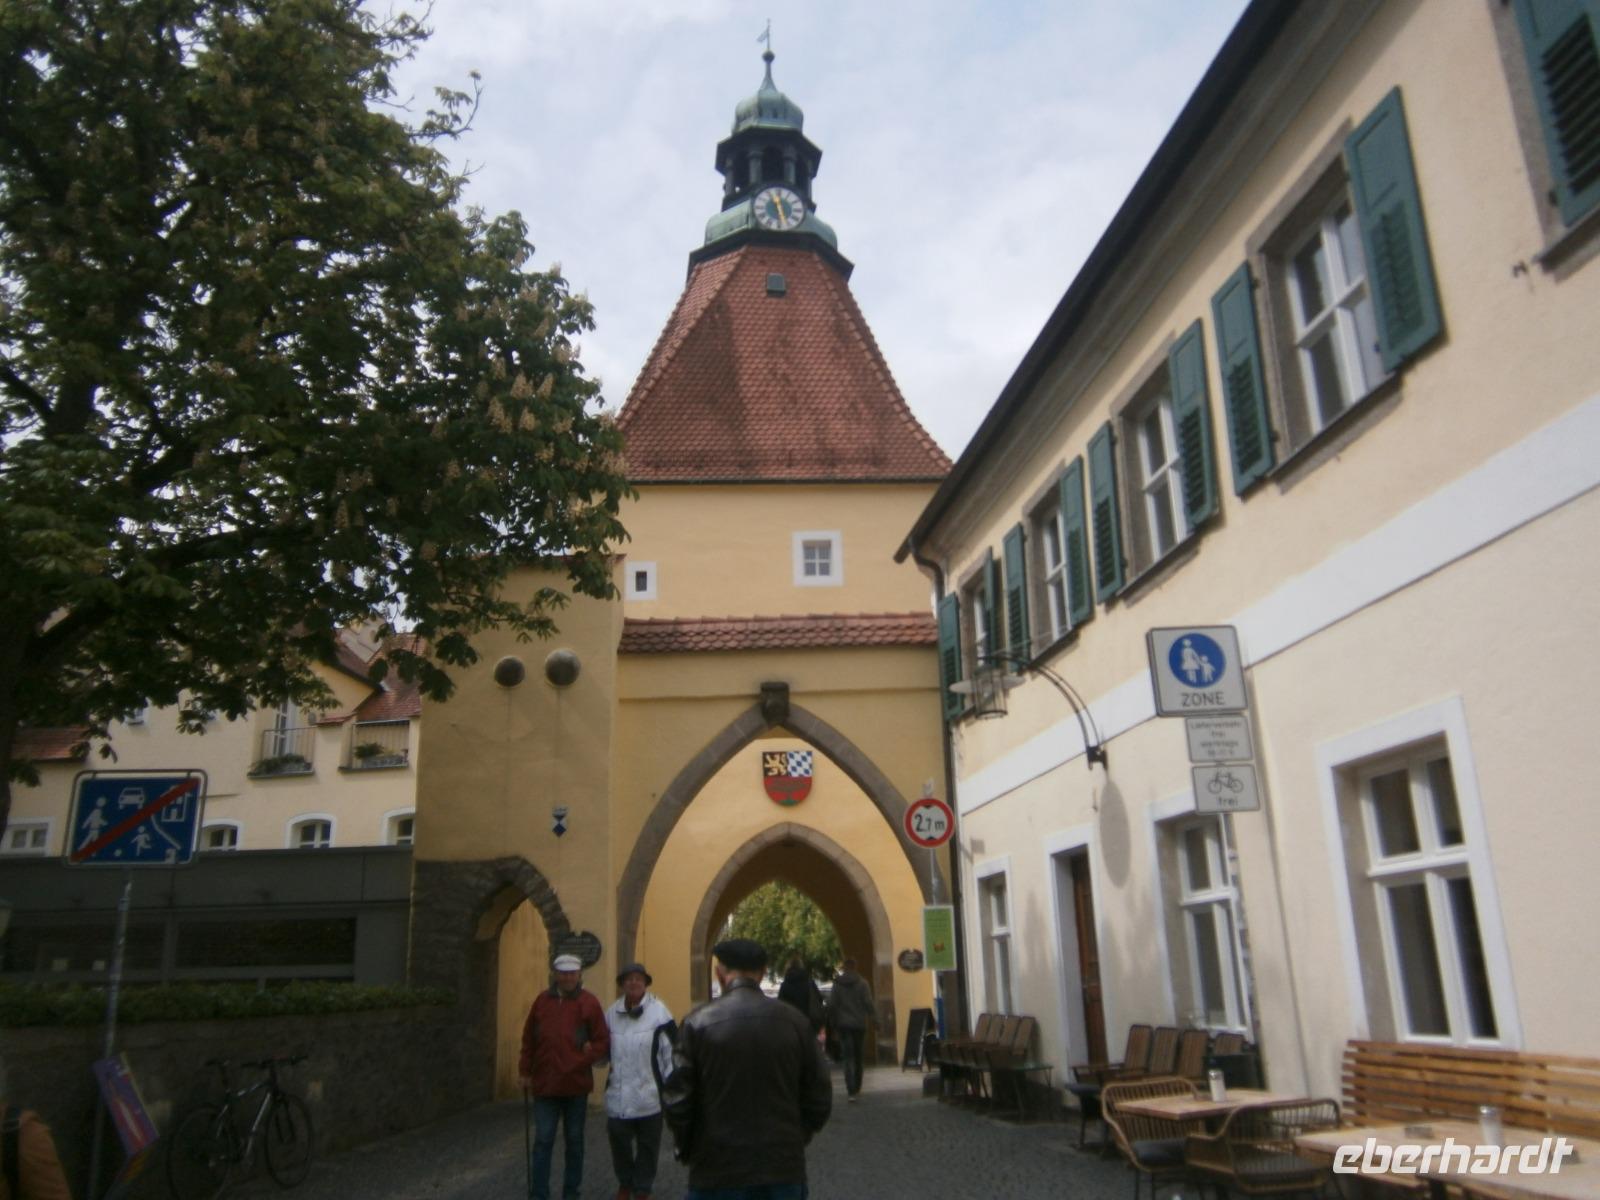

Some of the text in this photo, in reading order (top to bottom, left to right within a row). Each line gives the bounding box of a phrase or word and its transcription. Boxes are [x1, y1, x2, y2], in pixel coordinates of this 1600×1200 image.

[1181, 692, 1225, 707] ZONE
[1217, 796, 1239, 806] frei
[934, 820, 945, 831] m
